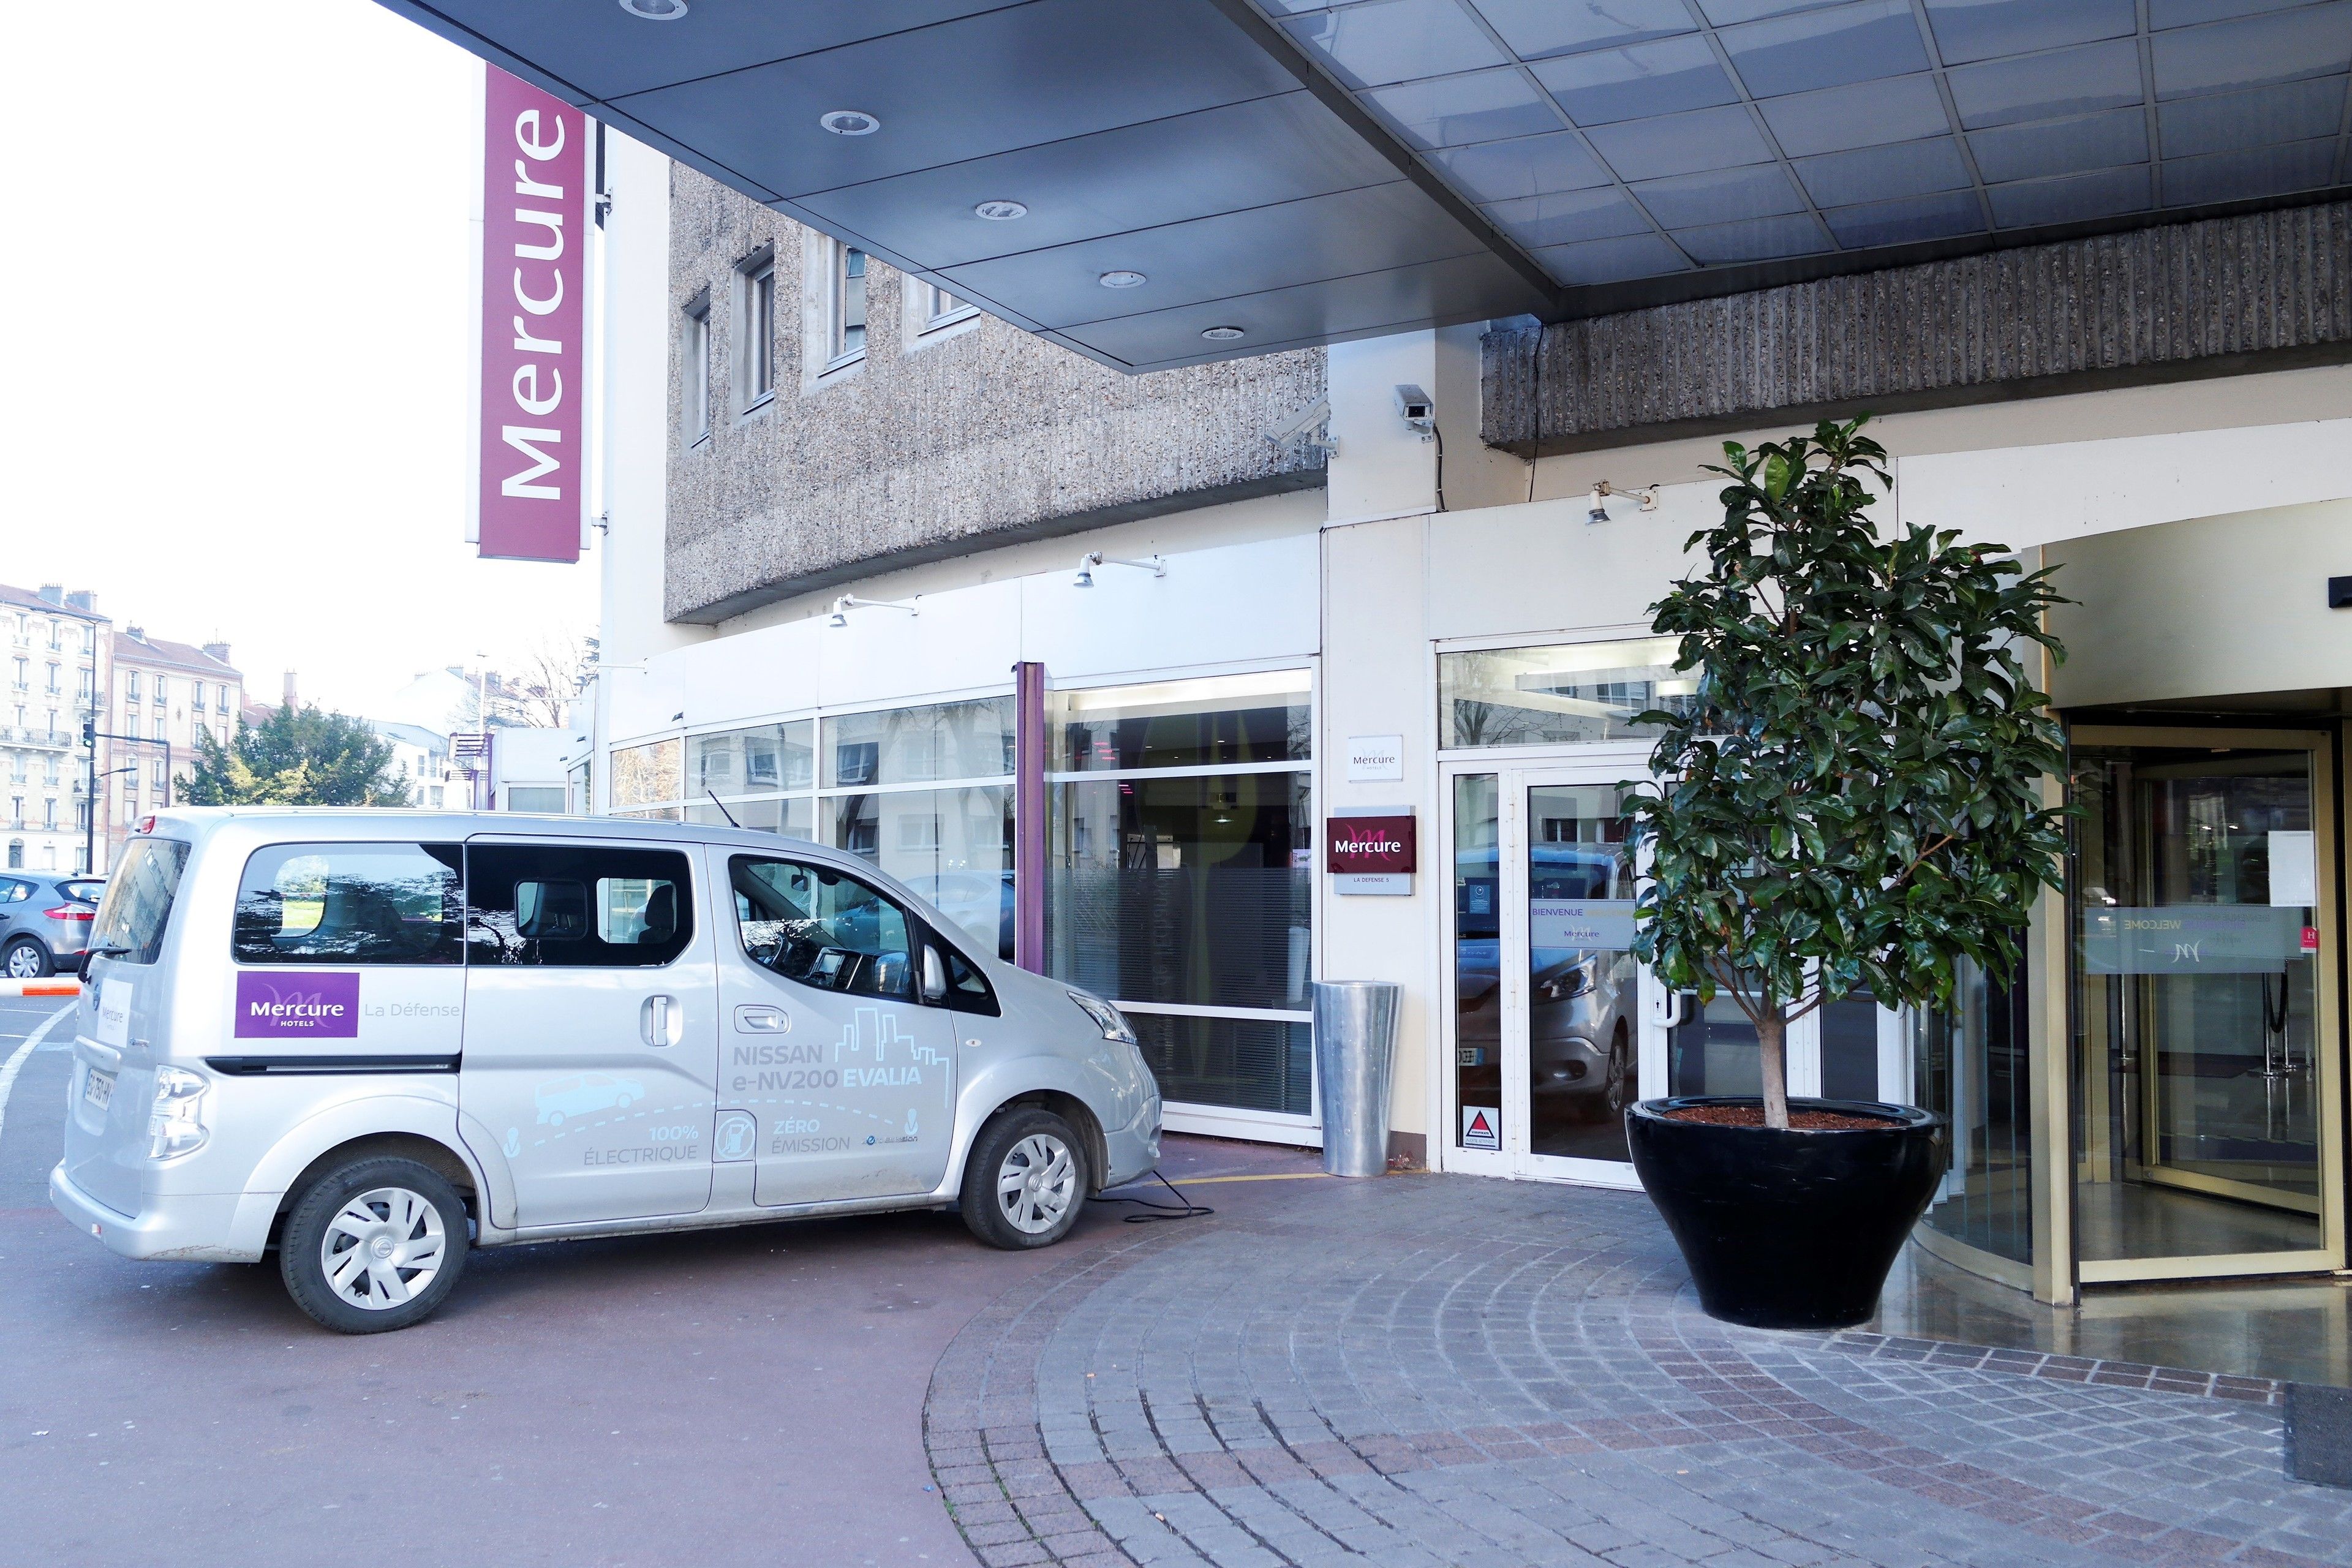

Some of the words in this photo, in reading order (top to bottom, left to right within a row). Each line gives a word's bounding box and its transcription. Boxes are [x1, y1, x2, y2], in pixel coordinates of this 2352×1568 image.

[501, 109, 565, 500] Mercure
[1354, 756, 1395, 764] Mercure
[1335, 840, 1401, 853] Mercure
[250, 1001, 345, 1017] Mercure
[364, 1004, 385, 1017] La
[390, 1002, 461, 1017] Défense
[733, 1044, 823, 1066] NISSAN
[732, 1069, 839, 1091] e-NV200
[843, 1066, 922, 1088] EVALIA
[649, 1125, 699, 1141] 100%
[772, 1116, 821, 1134] ZÉRO
[771, 1136, 850, 1155] ÉMISSION
[584, 1145, 698, 1166] ÉLECTRIQUE
